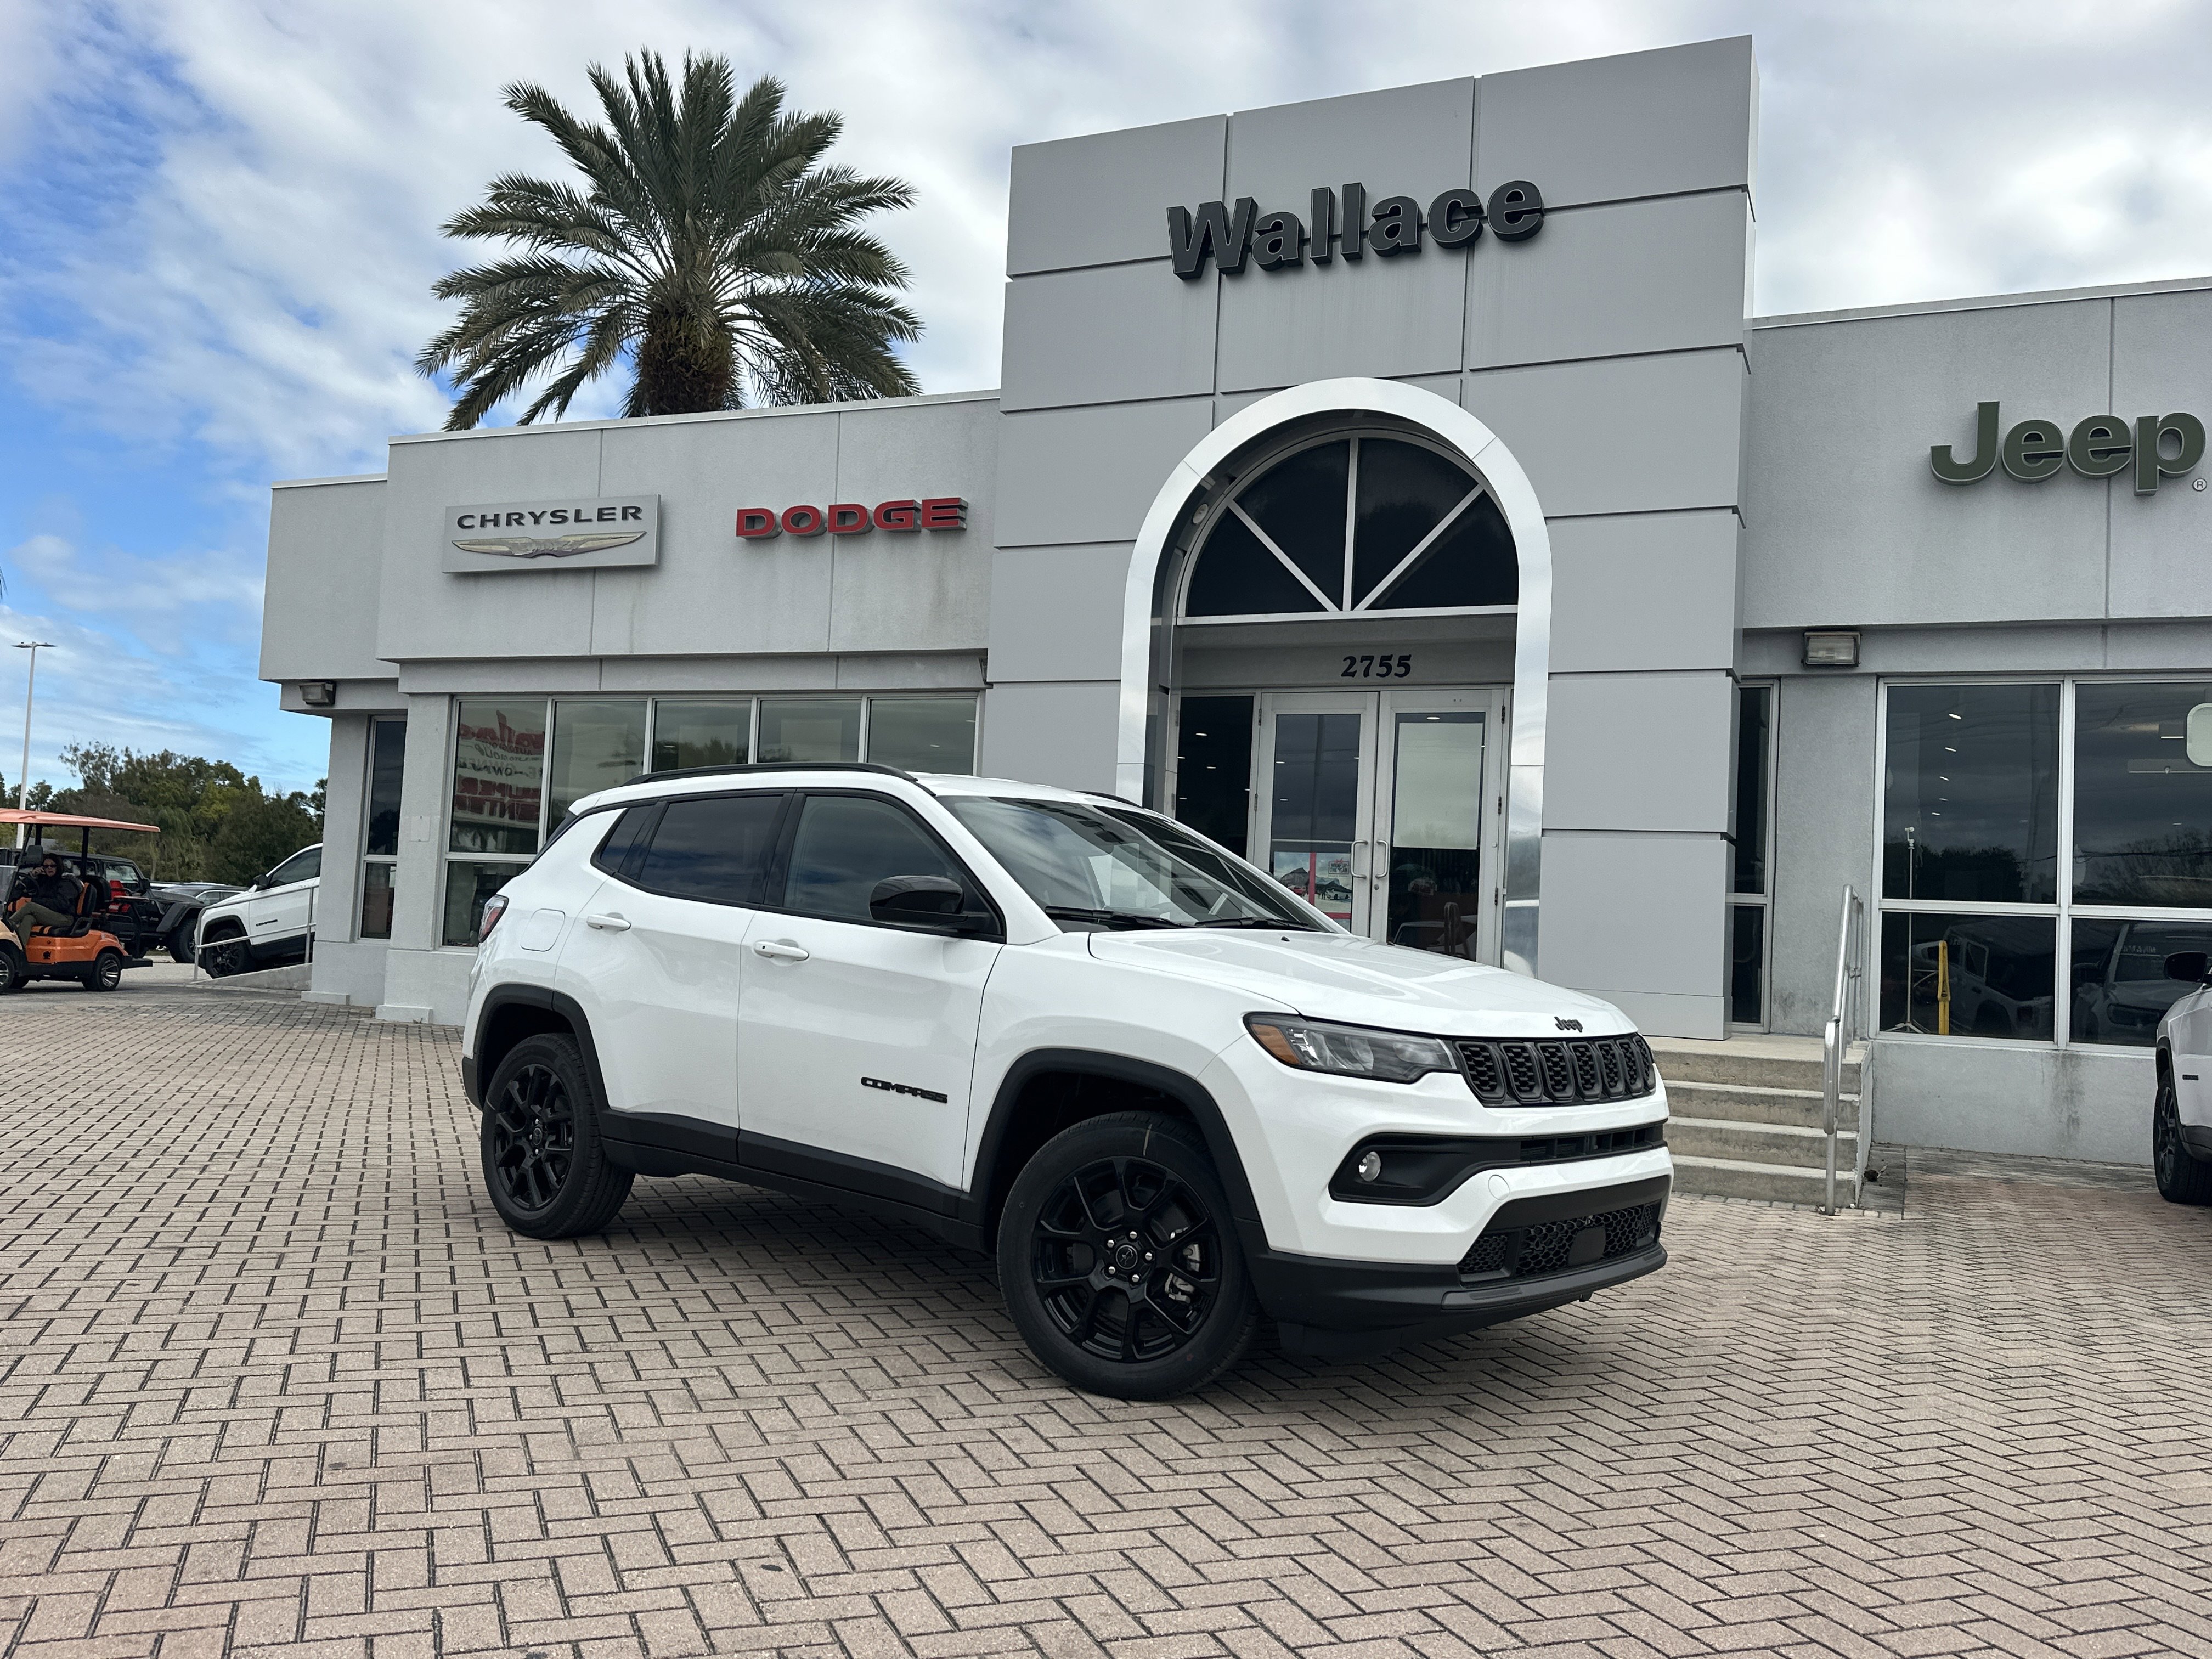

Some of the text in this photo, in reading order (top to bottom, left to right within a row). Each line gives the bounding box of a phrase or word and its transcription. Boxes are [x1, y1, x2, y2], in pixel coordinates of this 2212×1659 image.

[1167, 180, 1544, 279] Wallace
[1930, 400, 2206, 496] Jeep
[456, 505, 644, 530] CHRYSLER
[736, 497, 969, 539] DODGE
[1340, 653, 1412, 679] 2755
[1554, 1016, 1583, 1033] Jeep
[861, 1077, 948, 1104] COMPASS
